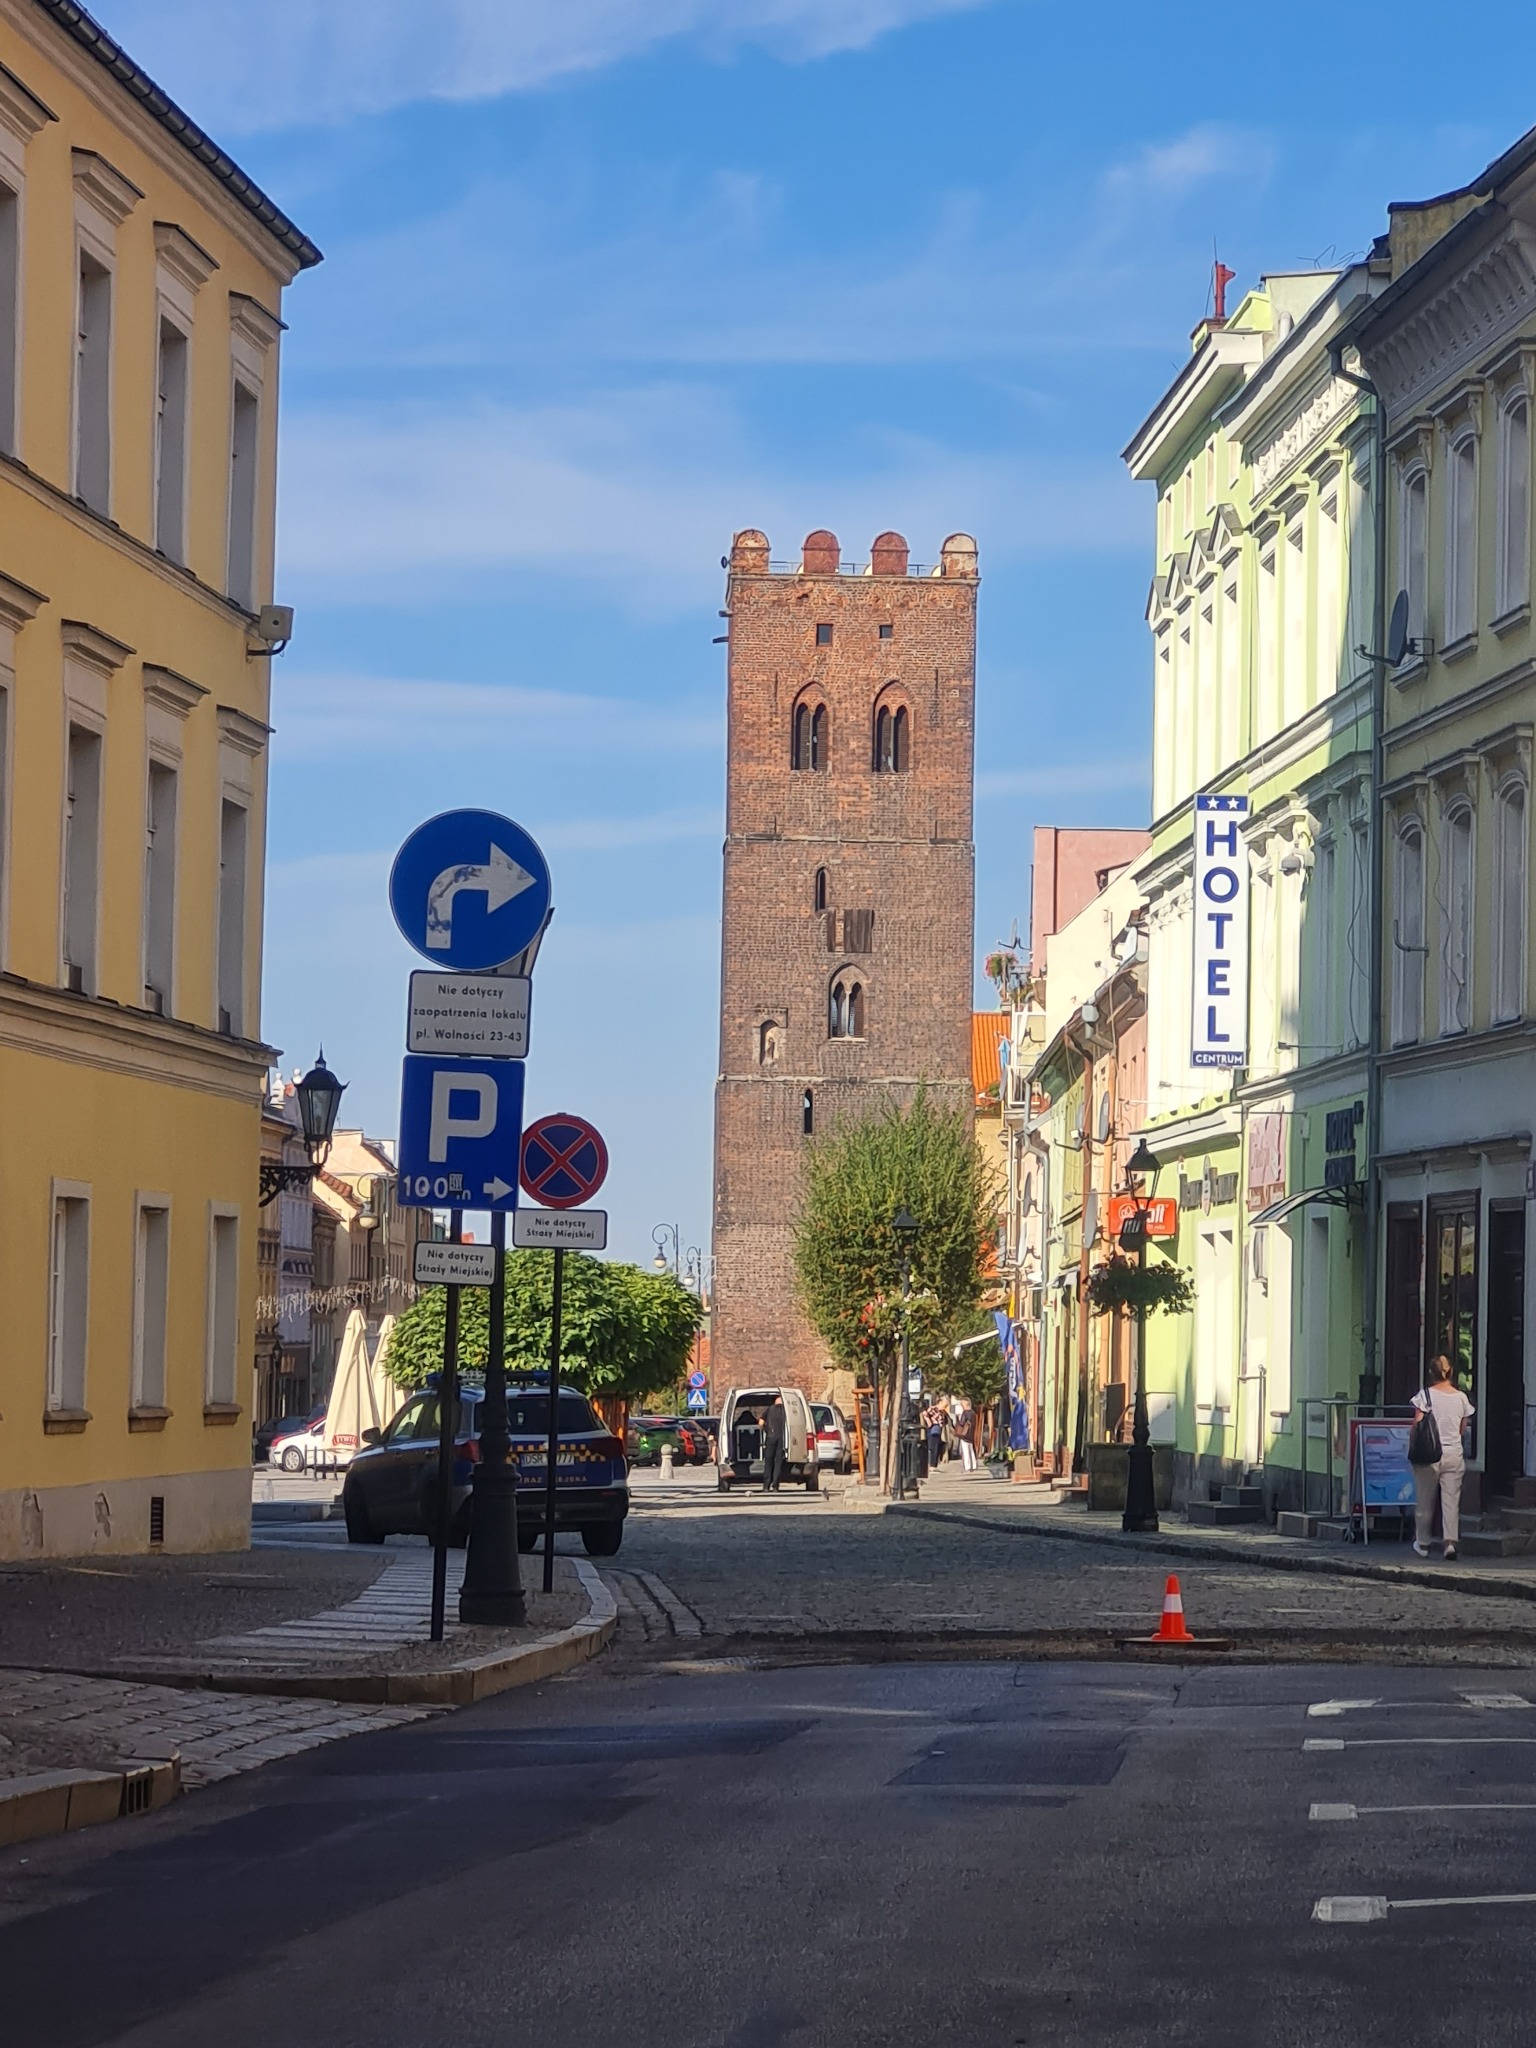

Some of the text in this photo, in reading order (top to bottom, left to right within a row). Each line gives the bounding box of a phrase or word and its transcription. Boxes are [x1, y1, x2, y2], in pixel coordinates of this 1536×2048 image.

[1203, 820, 1240, 1042] HOTEL
[438, 985, 504, 999] Nie dotyczy
[413, 1008, 526, 1020] zaopatrzenia lokalu
[416, 1028, 522, 1042] pl. Wolności 23-43
[1195, 1053, 1243, 1064] CENTRUM
[429, 1070, 498, 1163] P
[535, 1218, 586, 1229] Nie dotyczy
[556, 1230, 595, 1240] Miejskiej
[427, 1249, 484, 1263] Nie dotyczy
[417, 1263, 493, 1279] Straży Miejskiej
